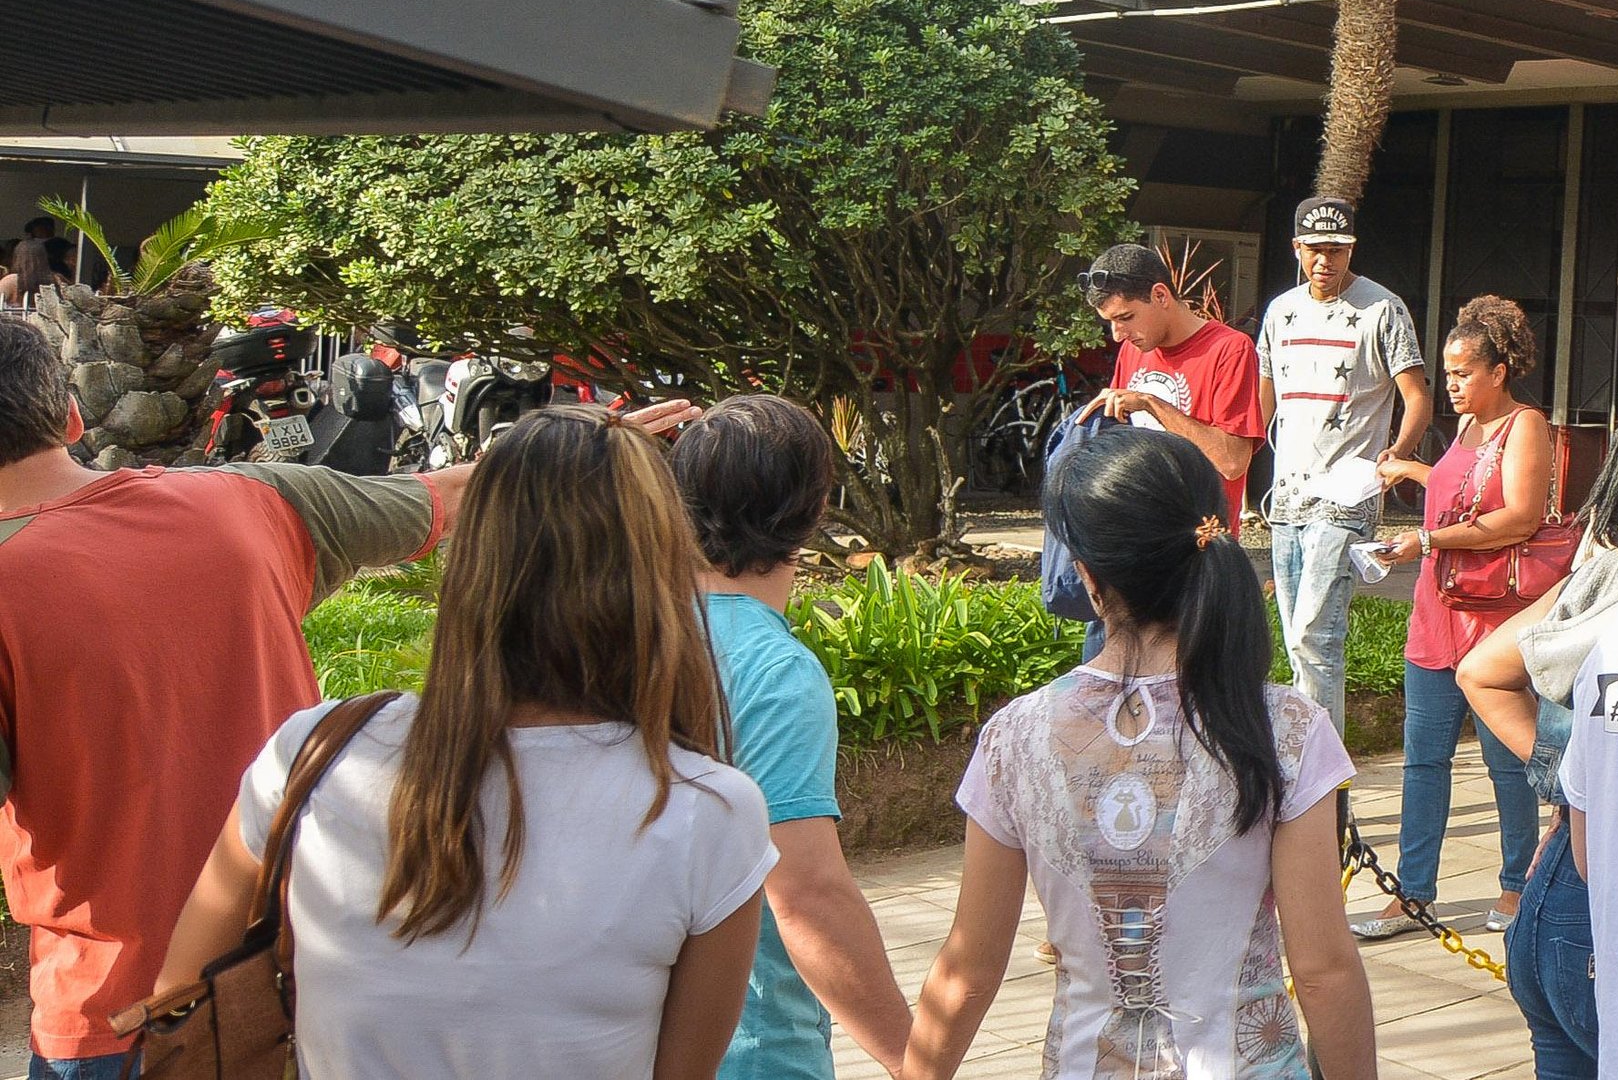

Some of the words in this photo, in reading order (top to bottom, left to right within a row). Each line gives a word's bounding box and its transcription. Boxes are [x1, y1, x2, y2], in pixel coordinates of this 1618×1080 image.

[1302, 206, 1348, 229] BROOKLYN
[272, 423, 303, 437] IXU
[272, 434, 308, 449] 9884
